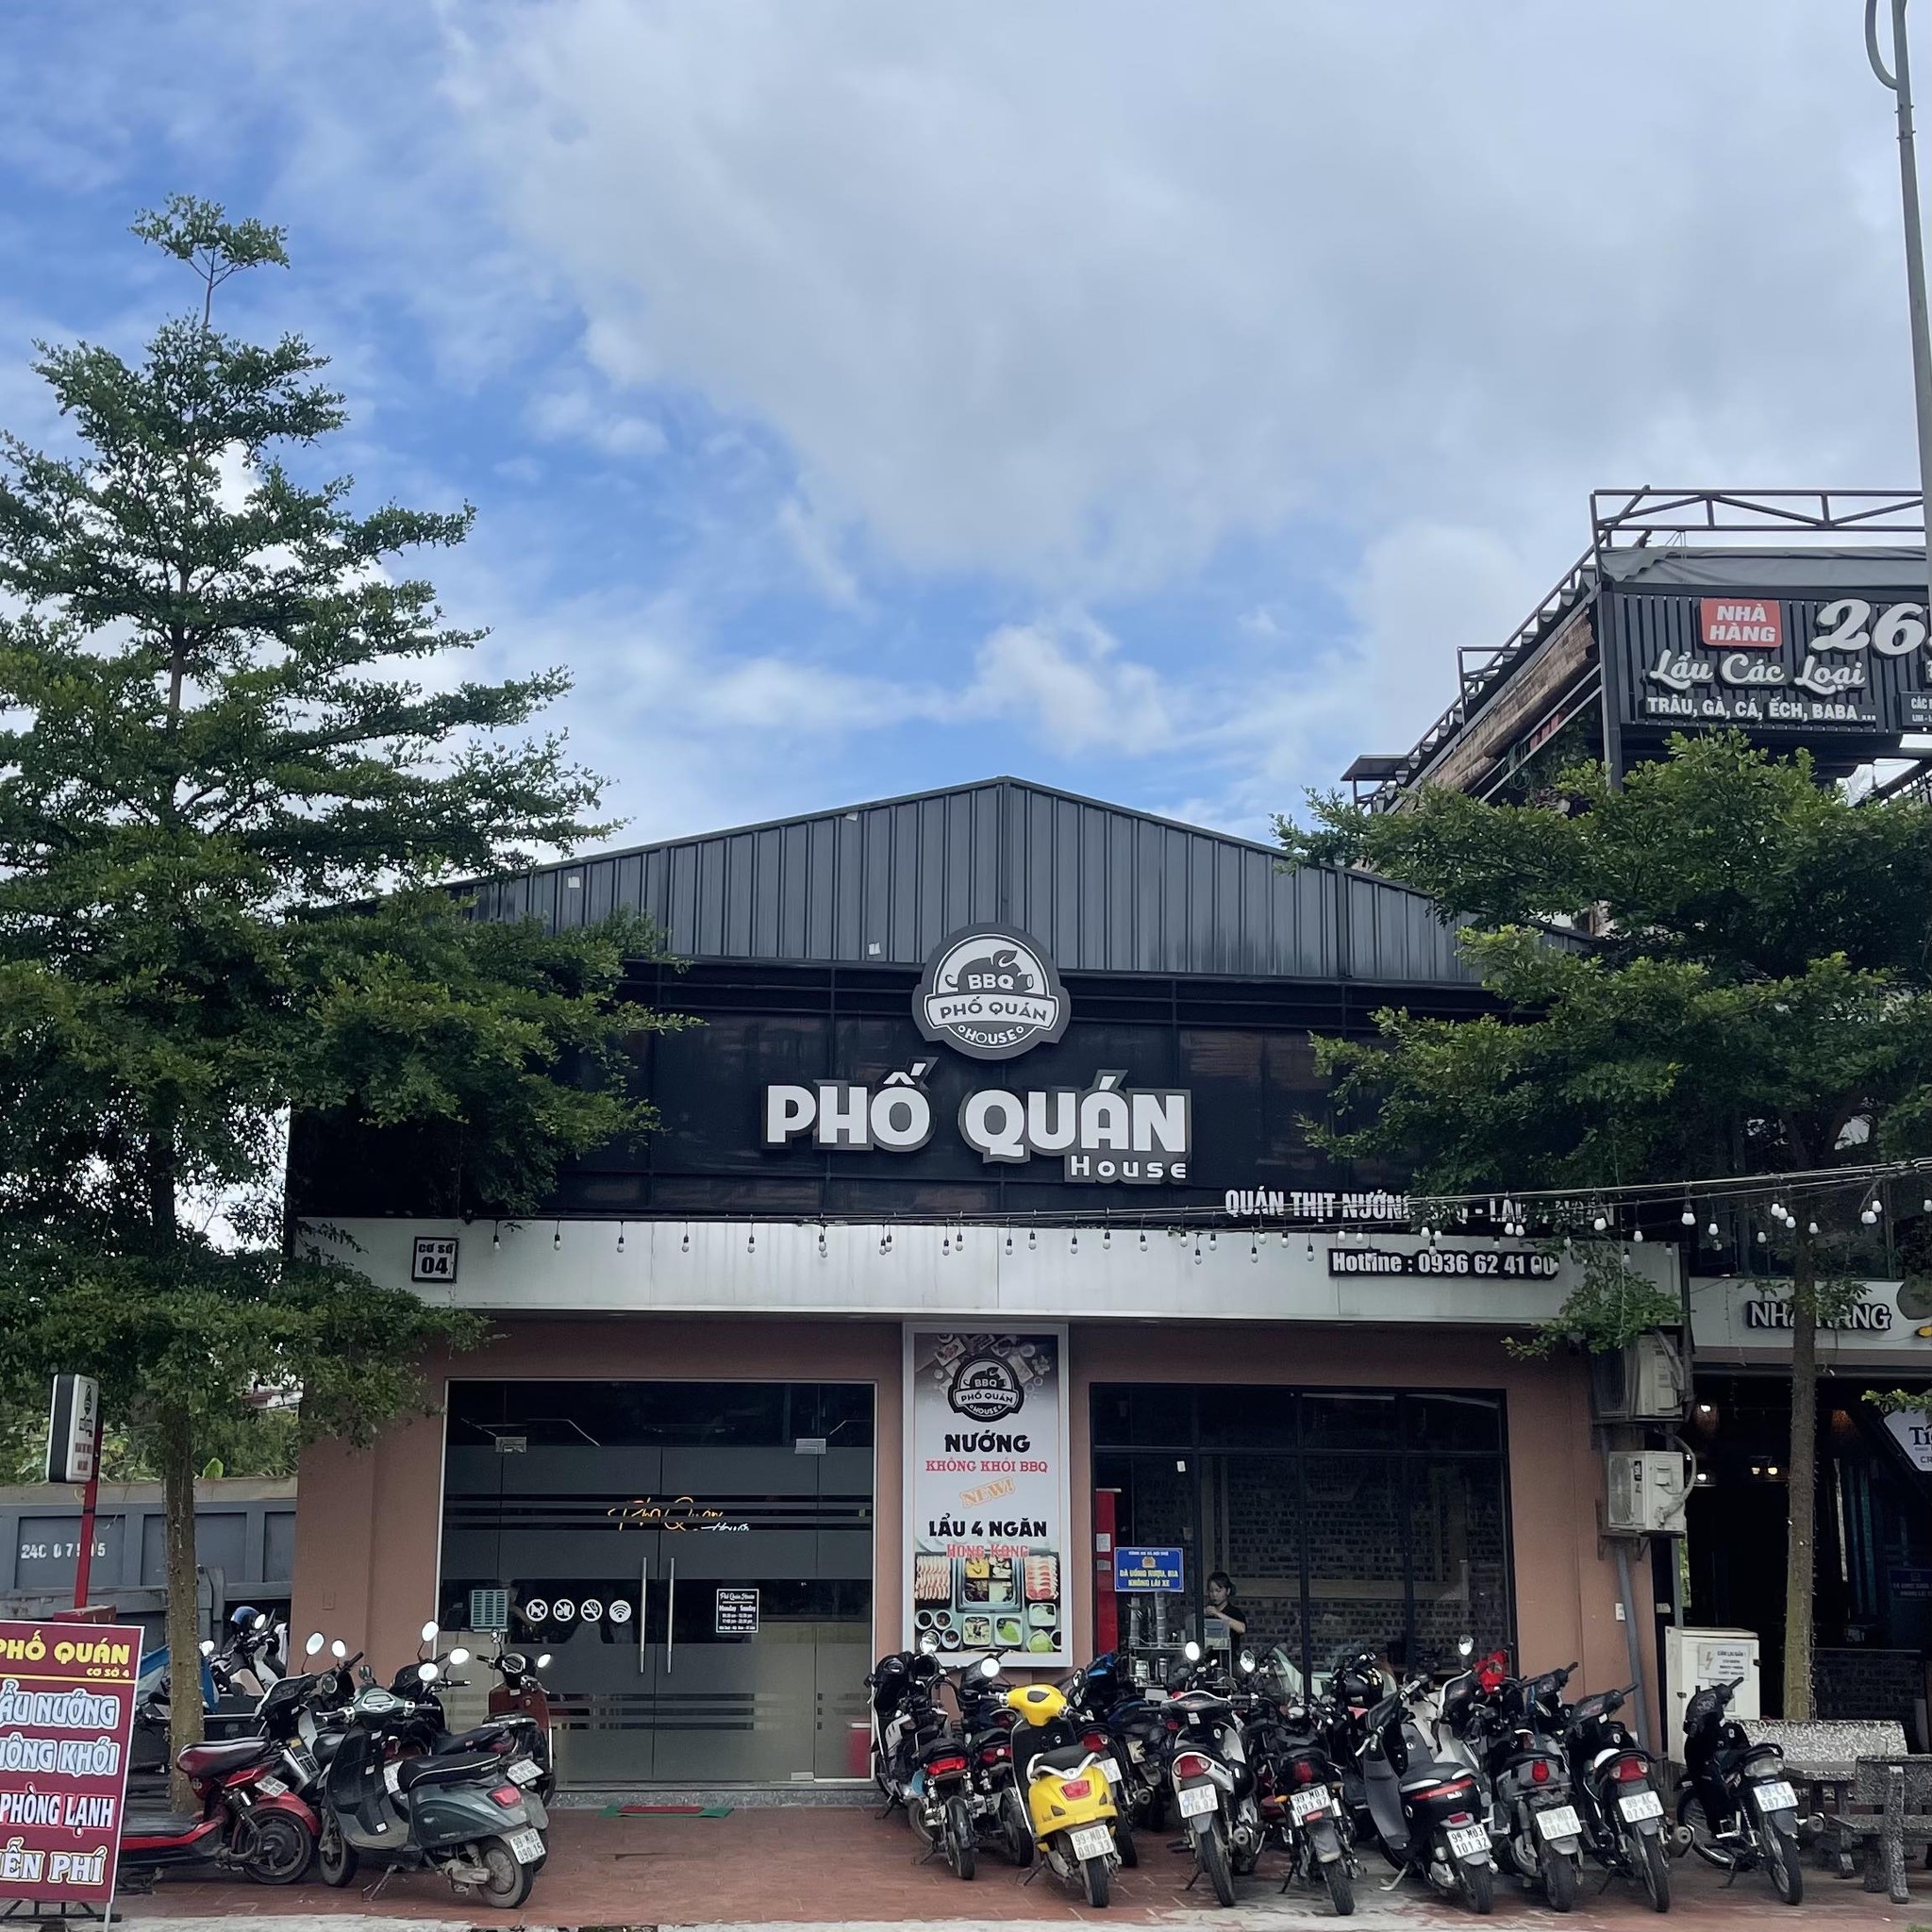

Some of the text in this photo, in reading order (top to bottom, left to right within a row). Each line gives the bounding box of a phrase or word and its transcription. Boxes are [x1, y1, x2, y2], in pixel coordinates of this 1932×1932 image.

[1716, 603, 1768, 623] NHÀ
[1708, 623, 1777, 642] HÀNG
[1721, 653, 1786, 685] Các
[1793, 655, 1866, 696] Loại
[1647, 696, 1697, 717] TRÂU,
[1735, 697, 1763, 721] CÁ,
[967, 973, 1014, 991] BBQ
[940, 995, 1047, 1022] PHỐ QUÁN
[964, 1028, 1018, 1045] HOUSE
[766, 1061, 1187, 1158] PHỐ QUÁN
[1225, 1186, 1284, 1218] QUÁN
[1290, 1191, 1336, 1223] THỊT
[421, 1257, 448, 1274] 04
[1332, 1252, 1403, 1273] Hotline
[1418, 1252, 1469, 1274] 0936
[1474, 1253, 1498, 1274] 62
[1504, 1255, 1525, 1274] 41
[1750, 1301, 1795, 1327] NH
[974, 1378, 997, 1388] BBQ
[960, 1391, 1013, 1404] PHỐ QUÁN
[973, 1406, 999, 1415] HOUSE
[944, 1429, 1031, 1453] NƯỚNG
[925, 1457, 1049, 1474] KHÔNG KHÓI BBQ
[928, 1512, 1047, 1537] LẨU 4 NGĂN
[21, 1543, 47, 1559] 24C
[54, 1637, 130, 1665] QUÁN
[0, 1680, 116, 1726] ẨU NƯỚNG
[60, 1739, 117, 1774] KHÓI
[0, 1785, 114, 1836] PHÒNG LẠNH
[50, 1848, 106, 1883] PHÍ
